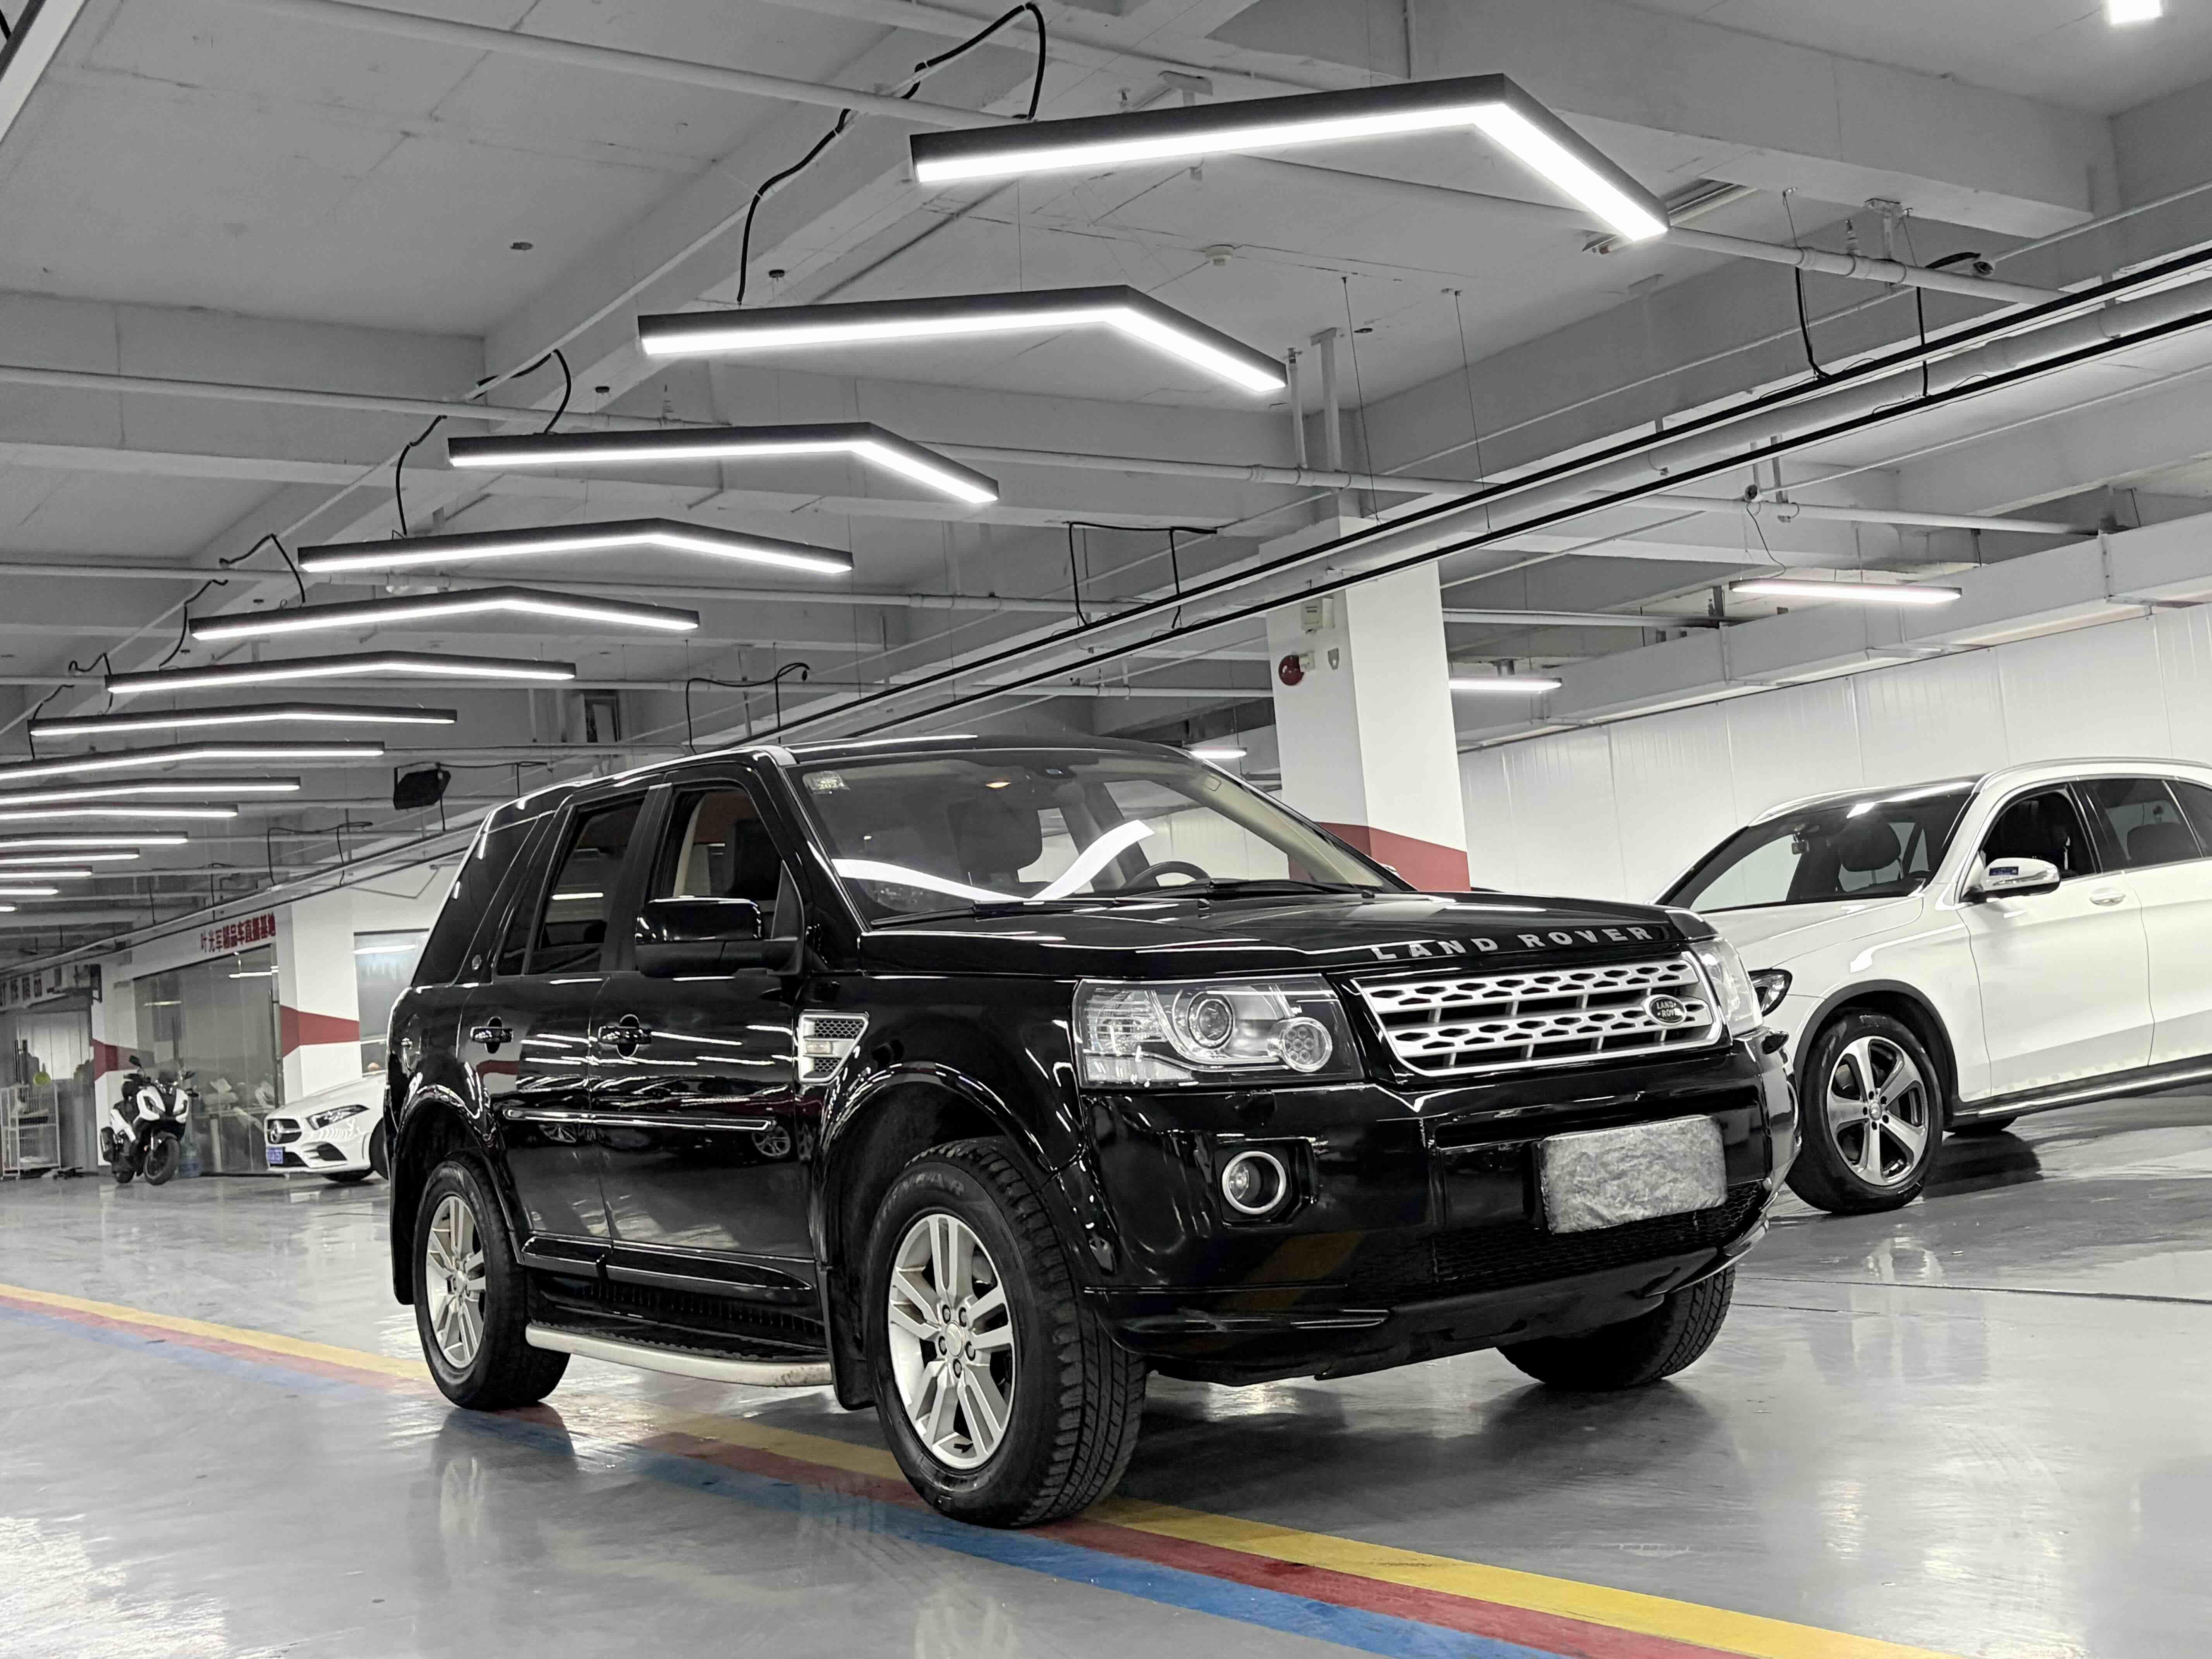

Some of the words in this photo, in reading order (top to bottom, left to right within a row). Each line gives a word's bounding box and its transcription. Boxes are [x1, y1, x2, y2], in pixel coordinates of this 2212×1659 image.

[1371, 938, 1498, 960] LAND
[1517, 927, 1653, 948] ROVER
[1657, 1001, 1673, 1010] LAND
